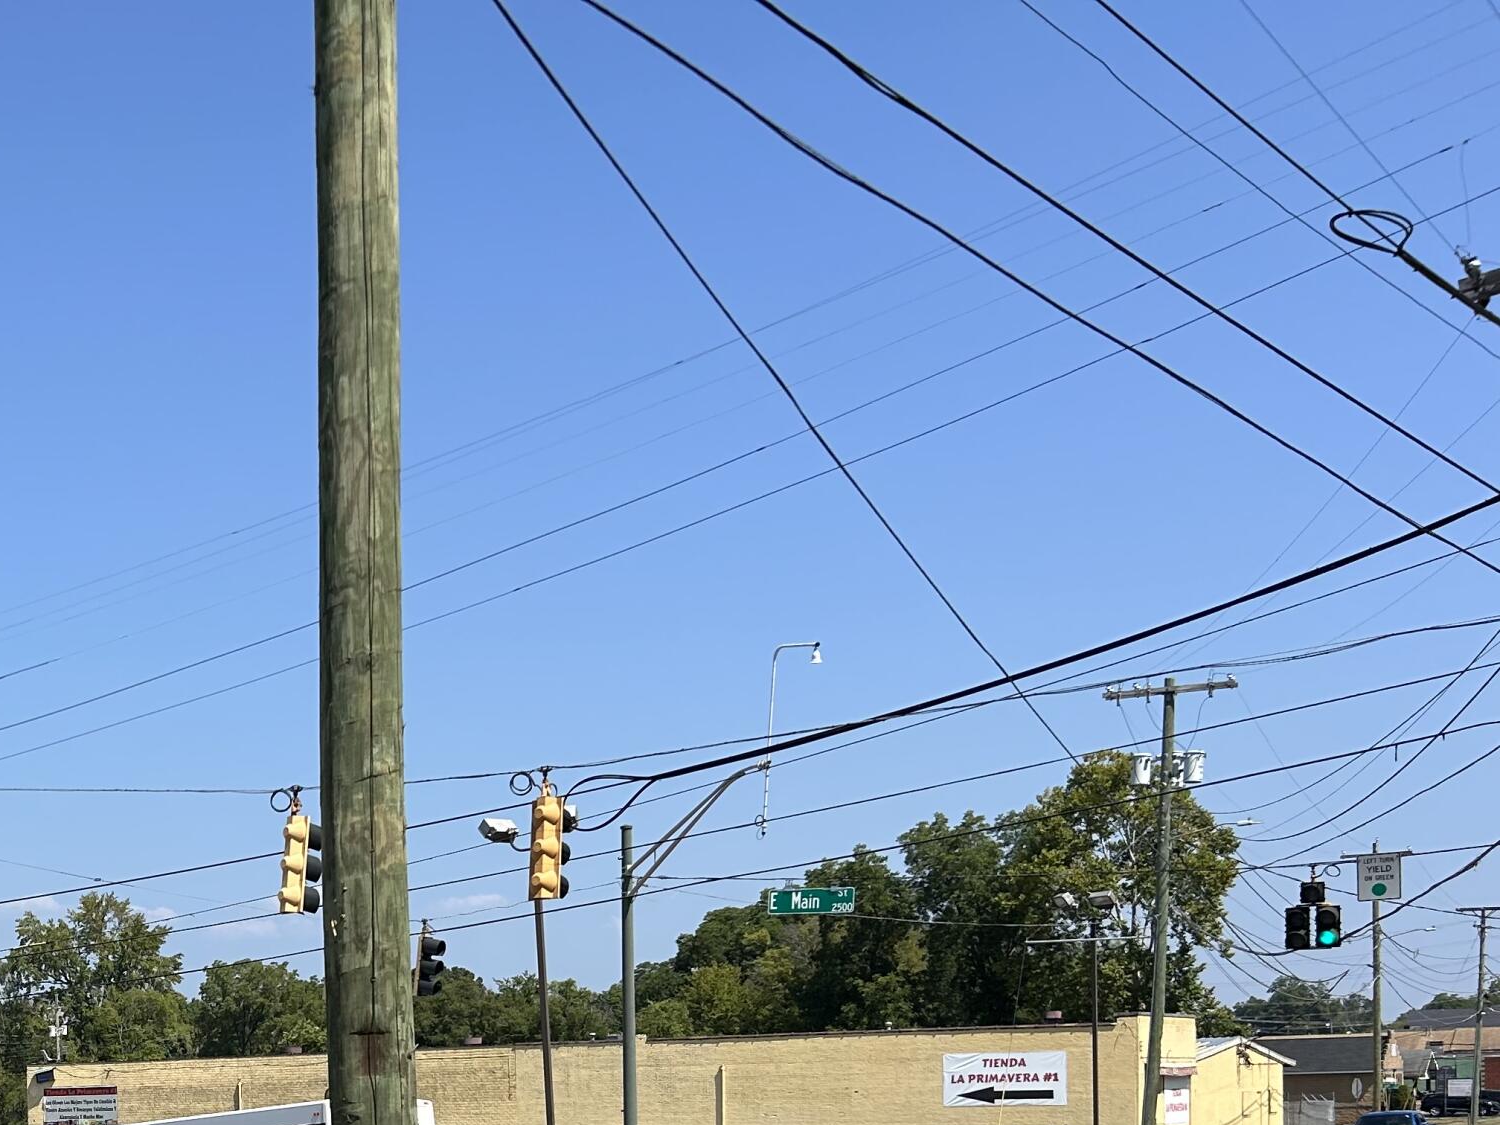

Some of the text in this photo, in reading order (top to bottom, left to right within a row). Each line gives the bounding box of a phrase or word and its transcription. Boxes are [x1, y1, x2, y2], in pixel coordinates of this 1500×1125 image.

[1367, 865, 1391, 873] YIELD
[770, 891, 820, 910] E Main
[831, 902, 853, 913] 2500
[982, 1058, 1026, 1068] TIENDA
[950, 1072, 1059, 1084] LA PRIMAVERA #1
